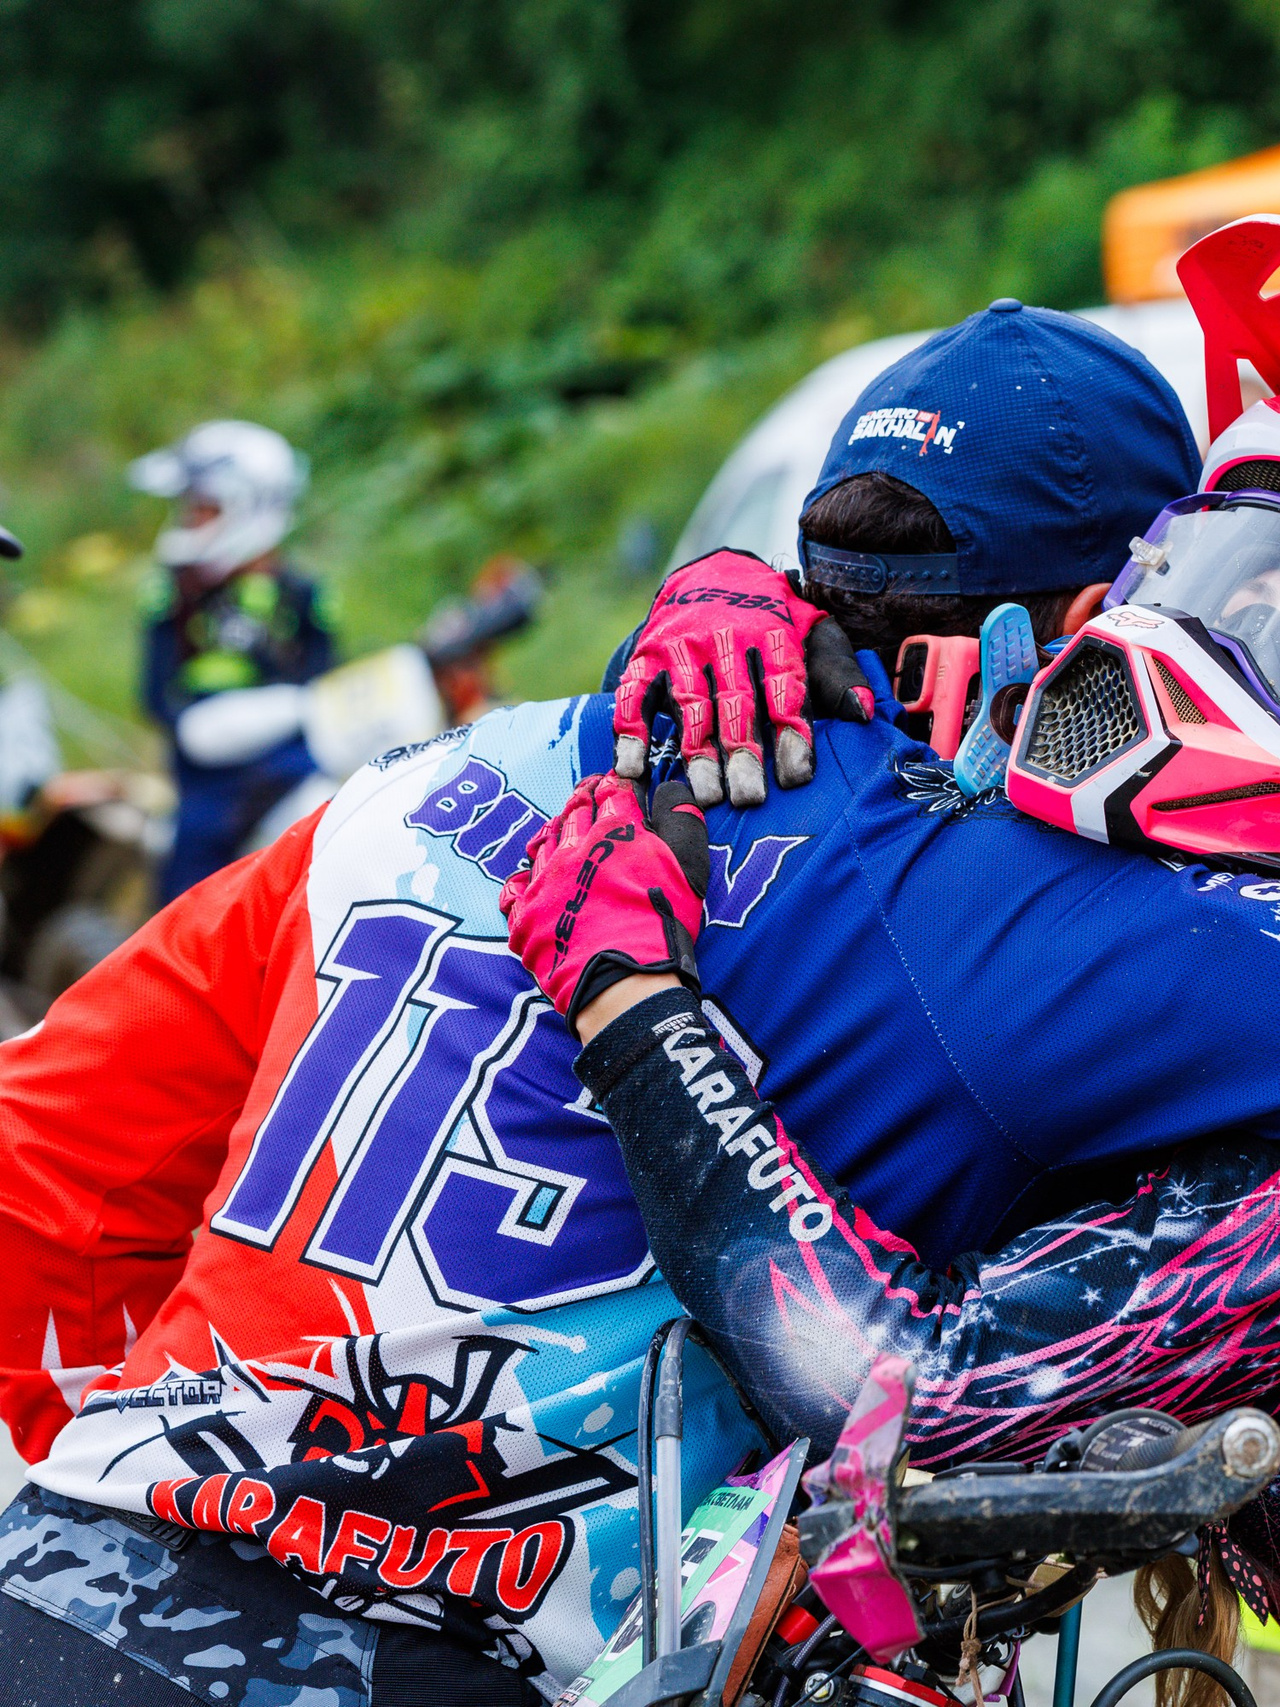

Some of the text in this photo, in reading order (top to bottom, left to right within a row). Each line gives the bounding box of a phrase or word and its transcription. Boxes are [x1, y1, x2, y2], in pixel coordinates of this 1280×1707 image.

[209, 899, 768, 1315] 115
[662, 1027, 833, 1242] KARAFUTO
[150, 1473, 566, 1613] KARAFUTO
